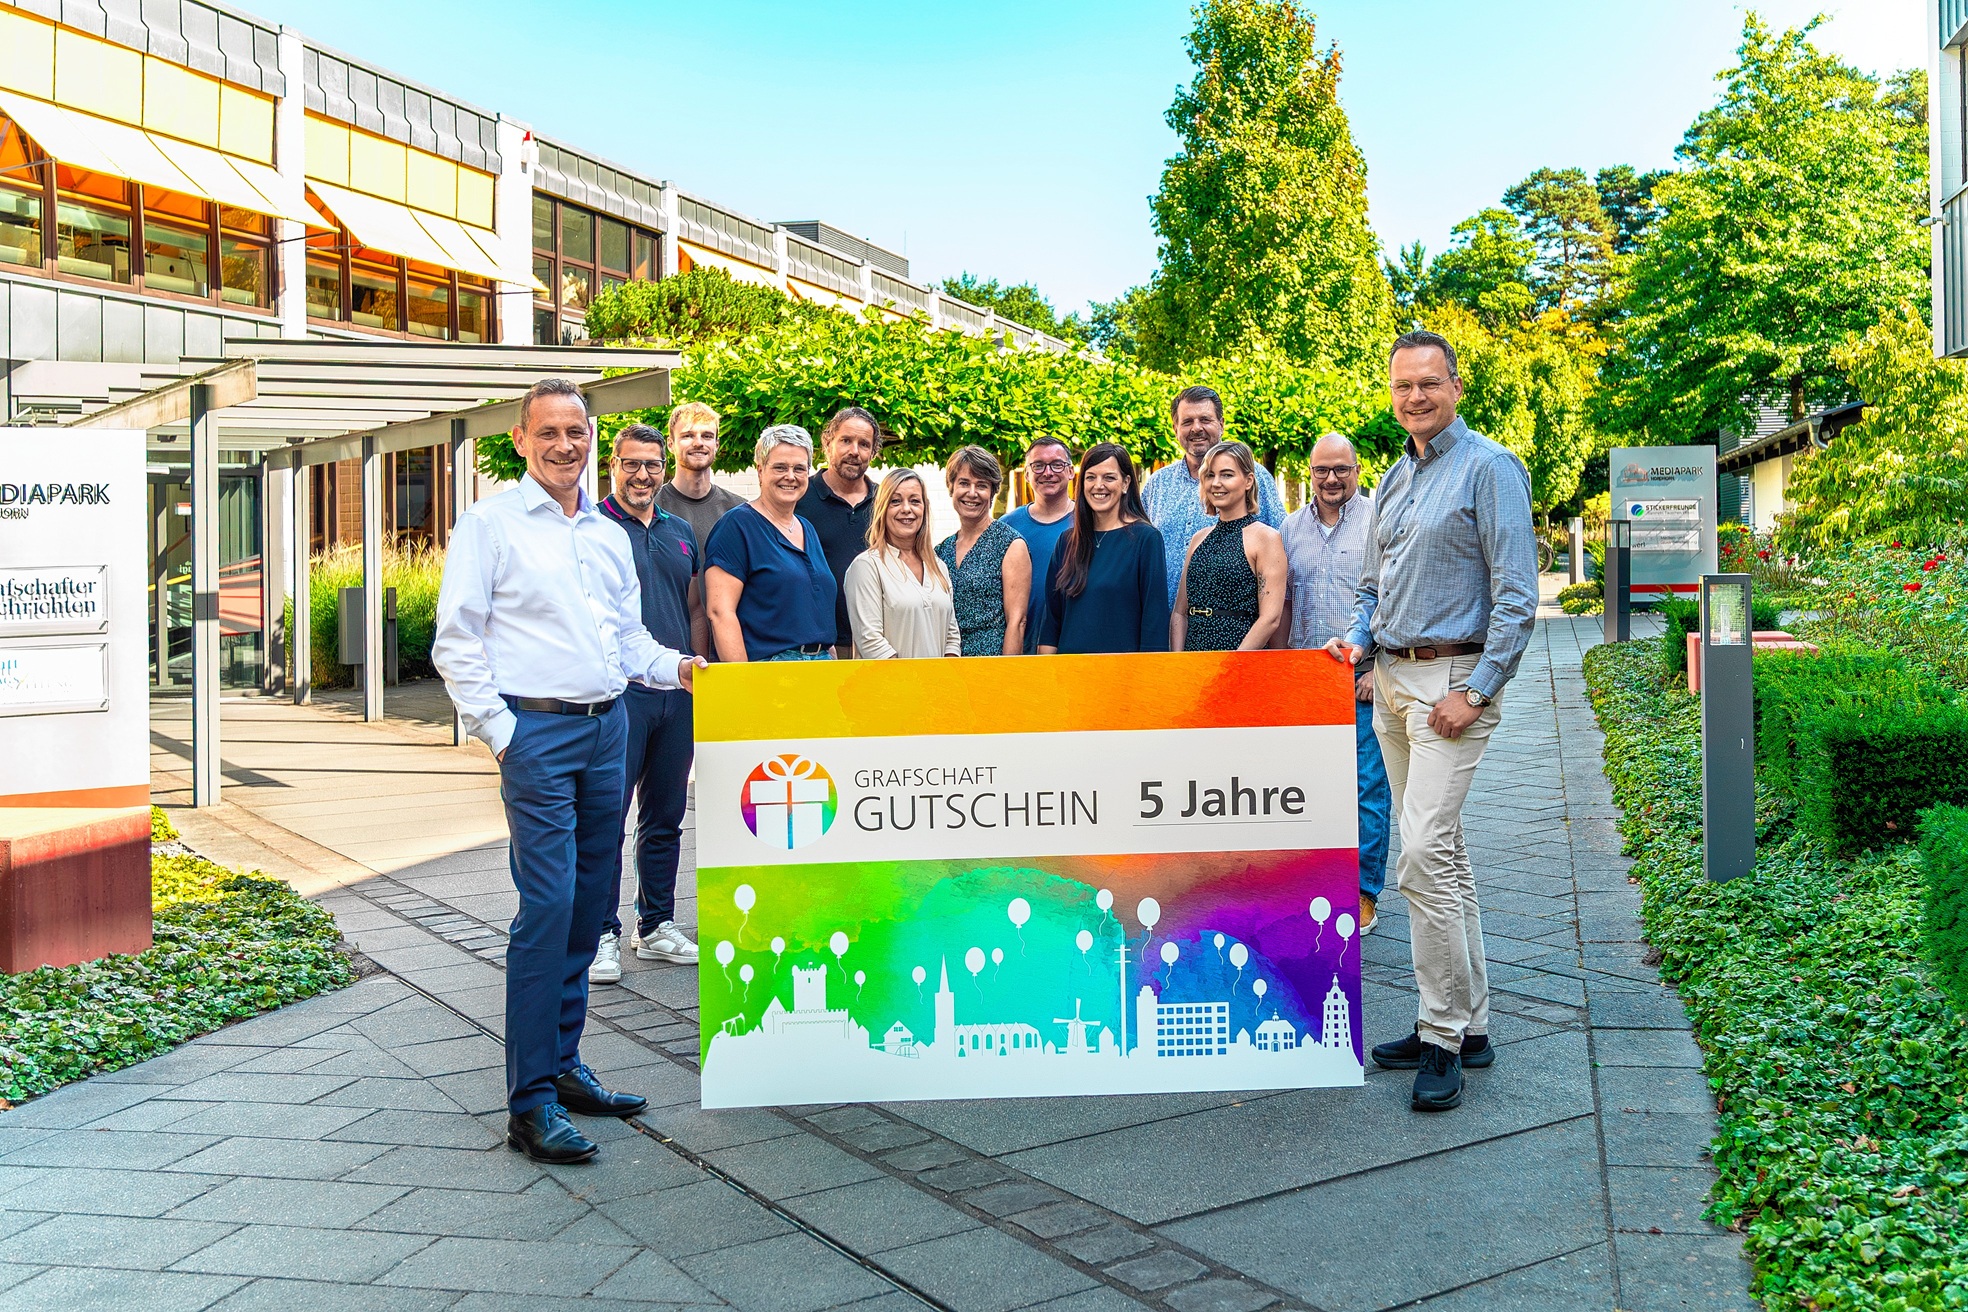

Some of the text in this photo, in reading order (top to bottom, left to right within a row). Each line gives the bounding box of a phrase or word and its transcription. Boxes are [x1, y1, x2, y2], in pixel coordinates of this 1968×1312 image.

[1650, 466, 1703, 476] MEDIAPARK
[854, 766, 997, 788] GRAFSCHAFT
[853, 790, 1098, 832] GUTSCHEIN
[1140, 776, 1306, 819] 5 Jahre
